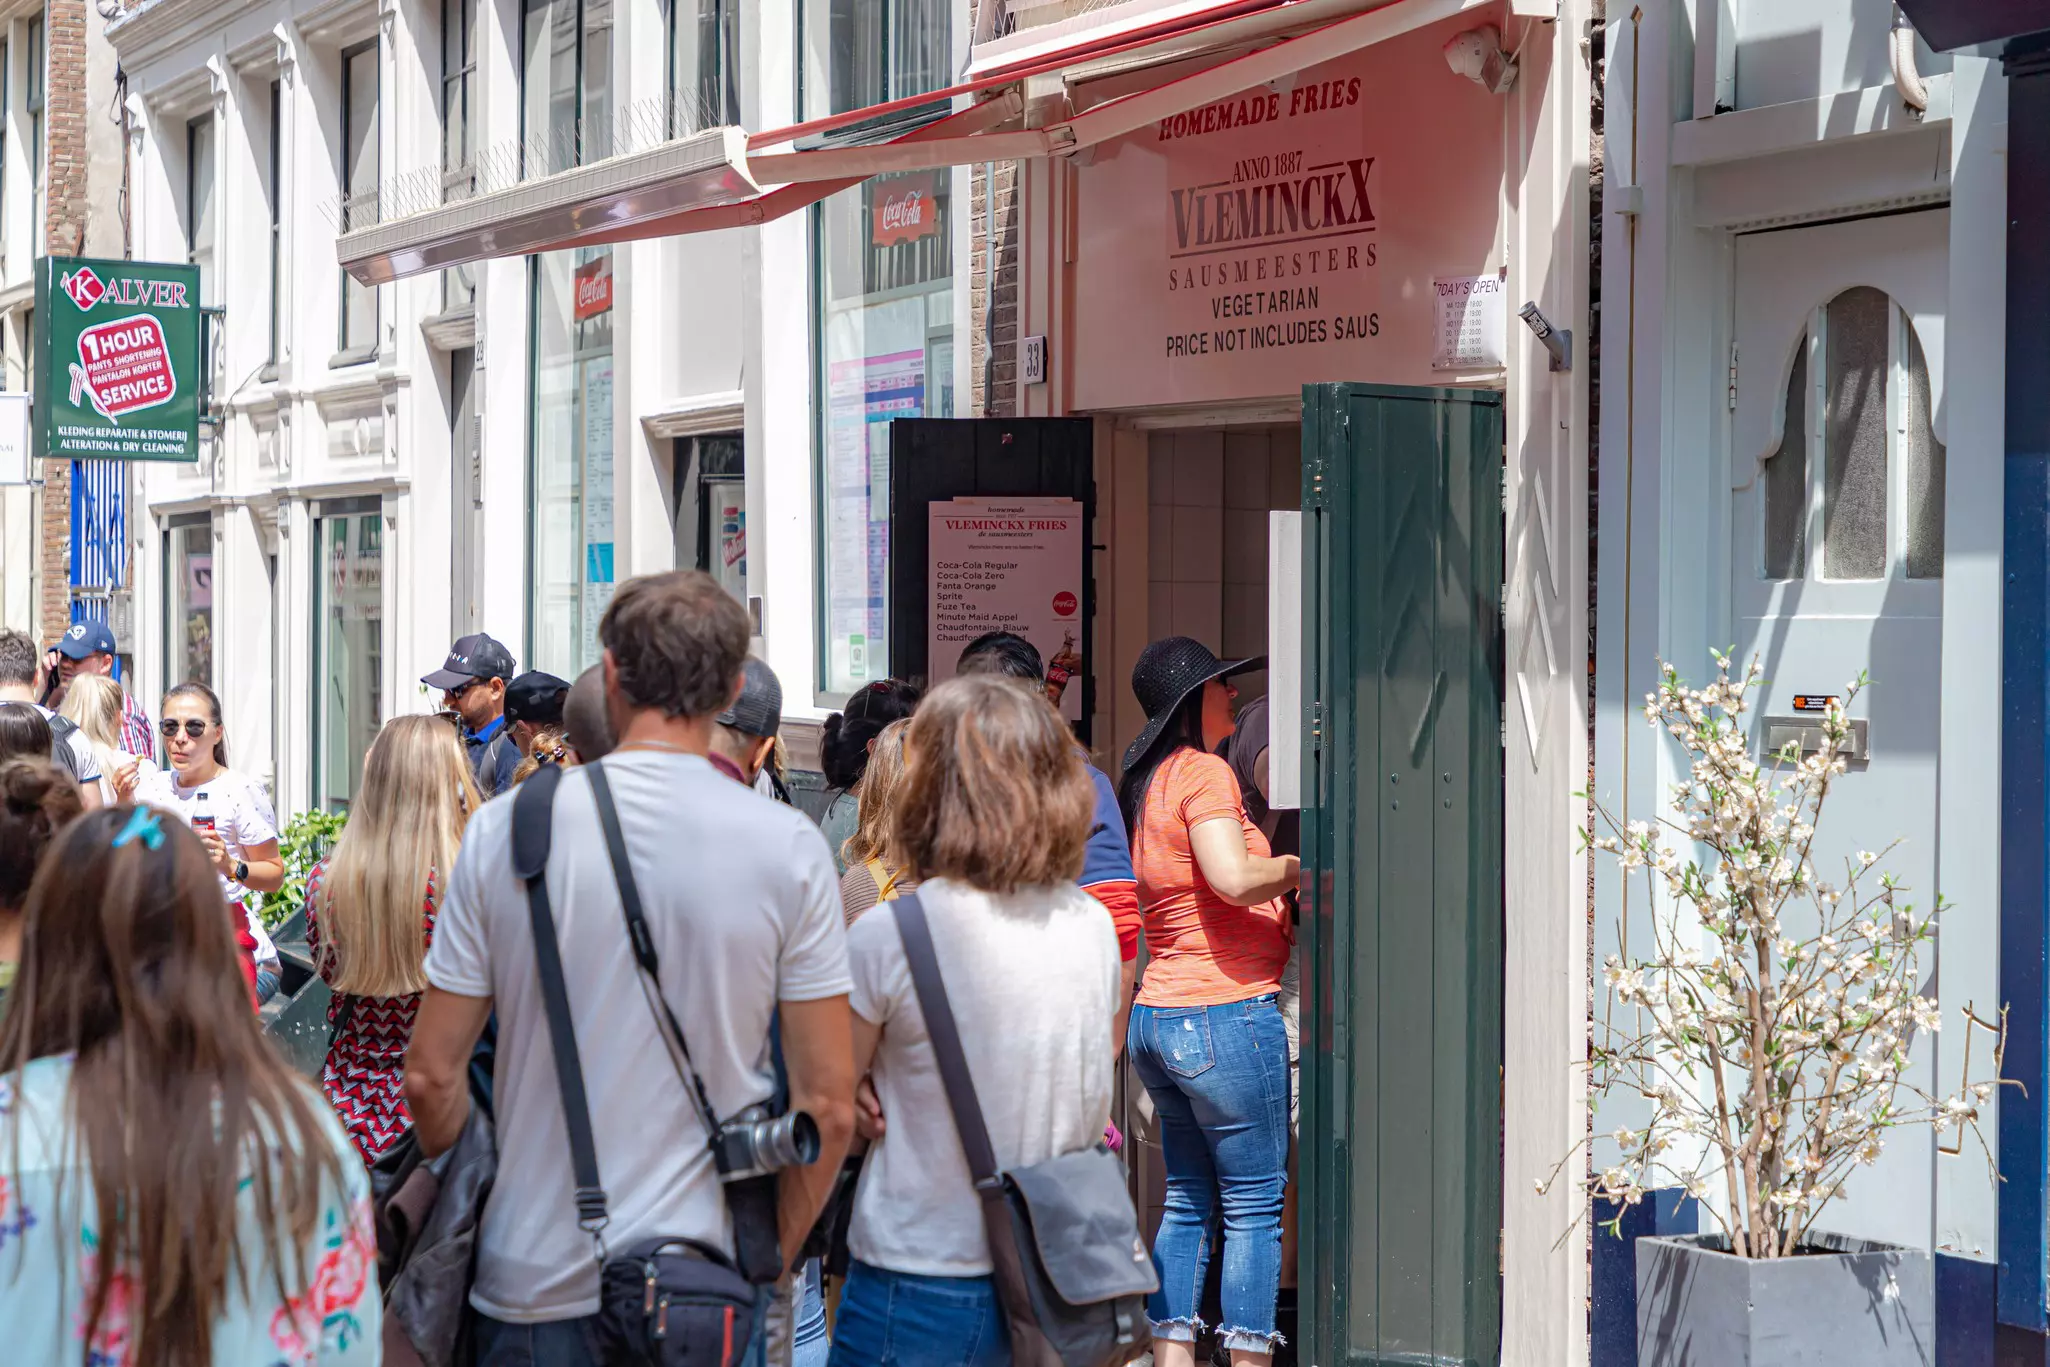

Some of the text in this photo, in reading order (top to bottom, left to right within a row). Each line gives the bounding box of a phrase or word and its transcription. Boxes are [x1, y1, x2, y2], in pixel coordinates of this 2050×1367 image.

[1159, 77, 1361, 141] HOMEMADE FRIES
[1232, 151, 1303, 183] ANNO 1887
[1171, 157, 1376, 249] VLEMINCKX
[1169, 243, 1377, 291] SAUSMEESTERS
[73, 274, 190, 308] KALVER
[1473, 280, 1499, 293] OPEN
[1212, 286, 1319, 319] VEGETARIAN
[83, 325, 155, 361] 1 HOUR
[1167, 312, 1379, 358] PRICE NOT INCLUDES SAUS
[87, 358, 113, 374] PANTS
[1027, 343, 1039, 377] 33
[91, 360, 163, 387] PANTALON KORTER
[101, 374, 169, 407] SERVICE
[57, 425, 188, 443] KLEDING REPARATIE & STOMERIJ
[60, 439, 185, 454] ALTERATION & DRY CLEANING
[946, 520, 1067, 530] VLEMINCKX FRIES
[937, 561, 1018, 571] Coca-Cola Regular
[937, 572, 1005, 580] Coca-Cola Zero
[937, 582, 996, 592] Fanta Orange
[937, 592, 963, 602] Sprite
[937, 603, 977, 611] Fuze Tea
[937, 613, 1018, 623] Minute Maid Appel
[937, 623, 1029, 632] Chaudfontaine Blauw
